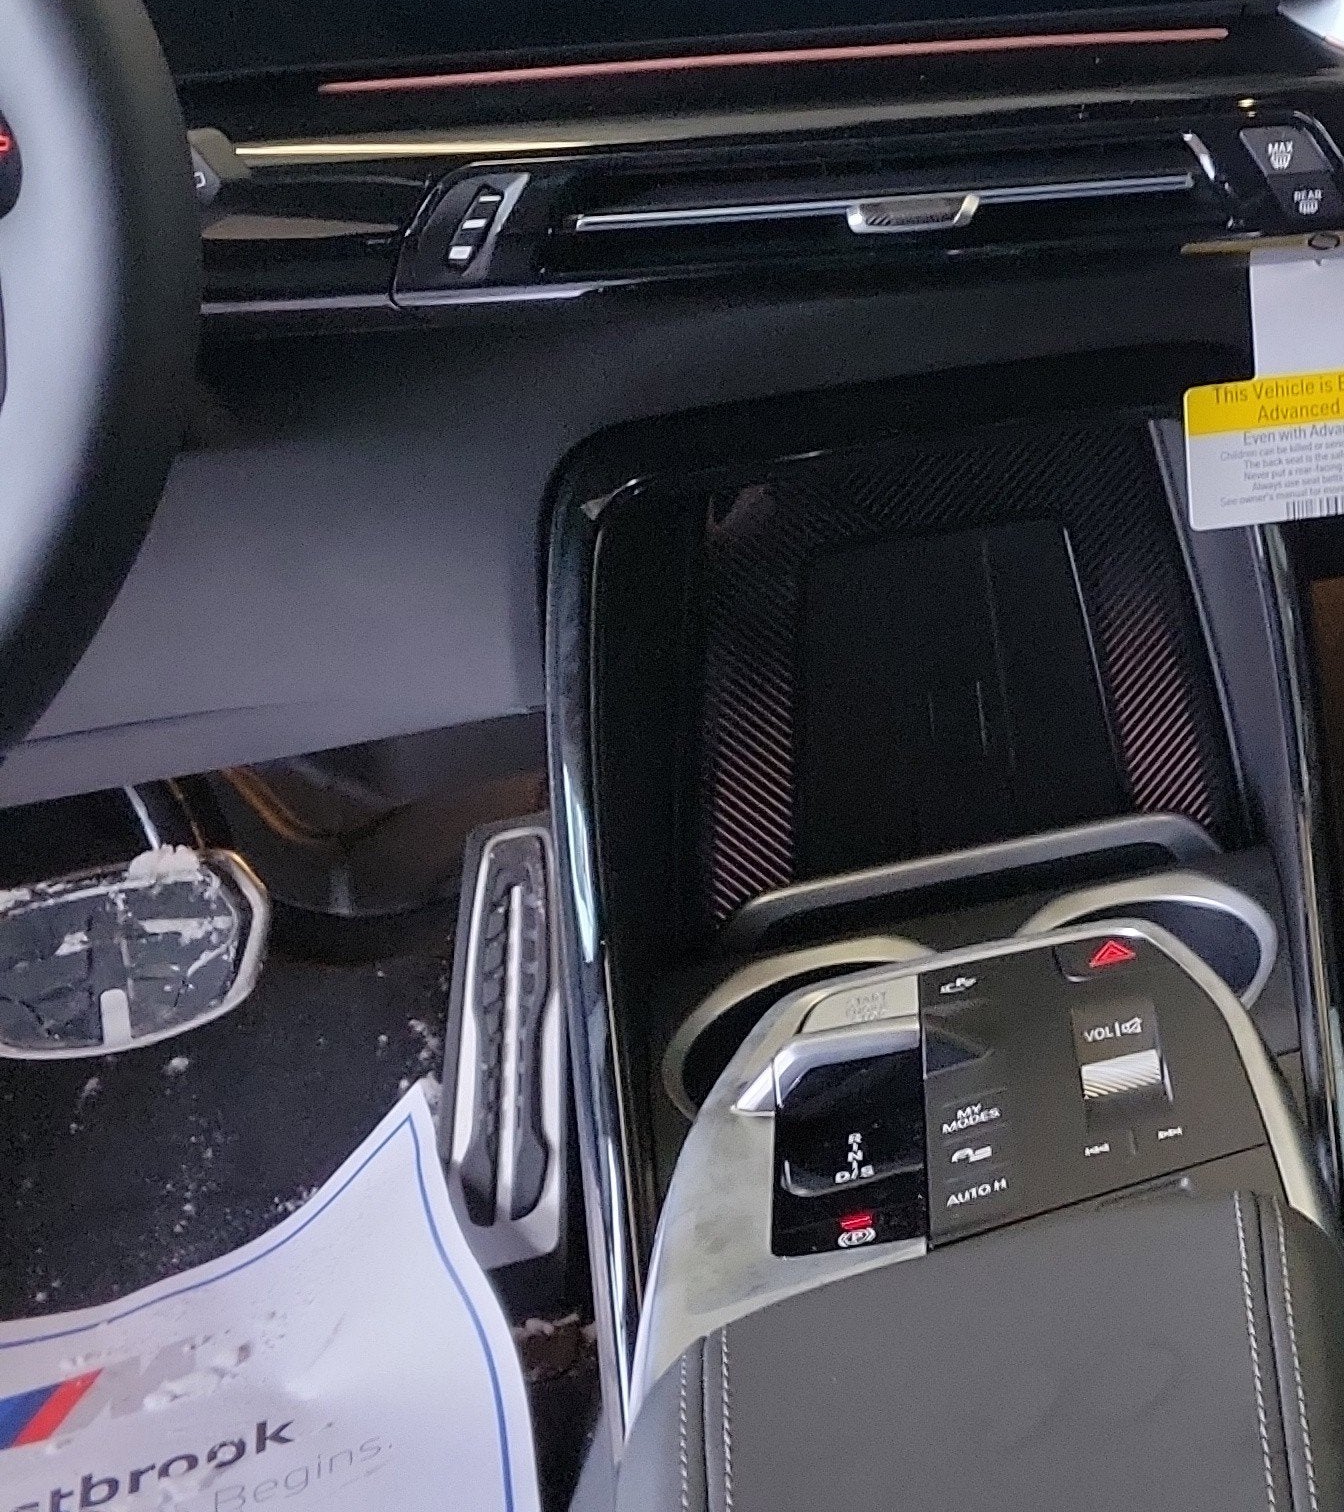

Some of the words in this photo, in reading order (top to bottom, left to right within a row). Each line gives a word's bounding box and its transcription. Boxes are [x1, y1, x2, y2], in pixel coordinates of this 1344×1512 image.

[1267, 140, 1294, 156] MAX
[1293, 189, 1323, 203] REAR
[1214, 385, 1248, 404] This
[1252, 377, 1314, 400] Vehicle
[1320, 376, 1333, 393] is
[1257, 397, 1340, 423] Advanced
[1243, 430, 1276, 446] Even
[1279, 426, 1307, 441] with
[1220, 448, 1257, 461] Children
[1290, 441, 1313, 453] killed
[1084, 1026, 1114, 1043] VOL
[942, 1107, 1001, 1135] MODES
[956, 1102, 982, 1120] MY
[847, 1149, 863, 1162] N
[946, 1183, 992, 1207] AUTO
[993, 1177, 1008, 1193] H
[213, 1435, 394, 1512] Begins.
